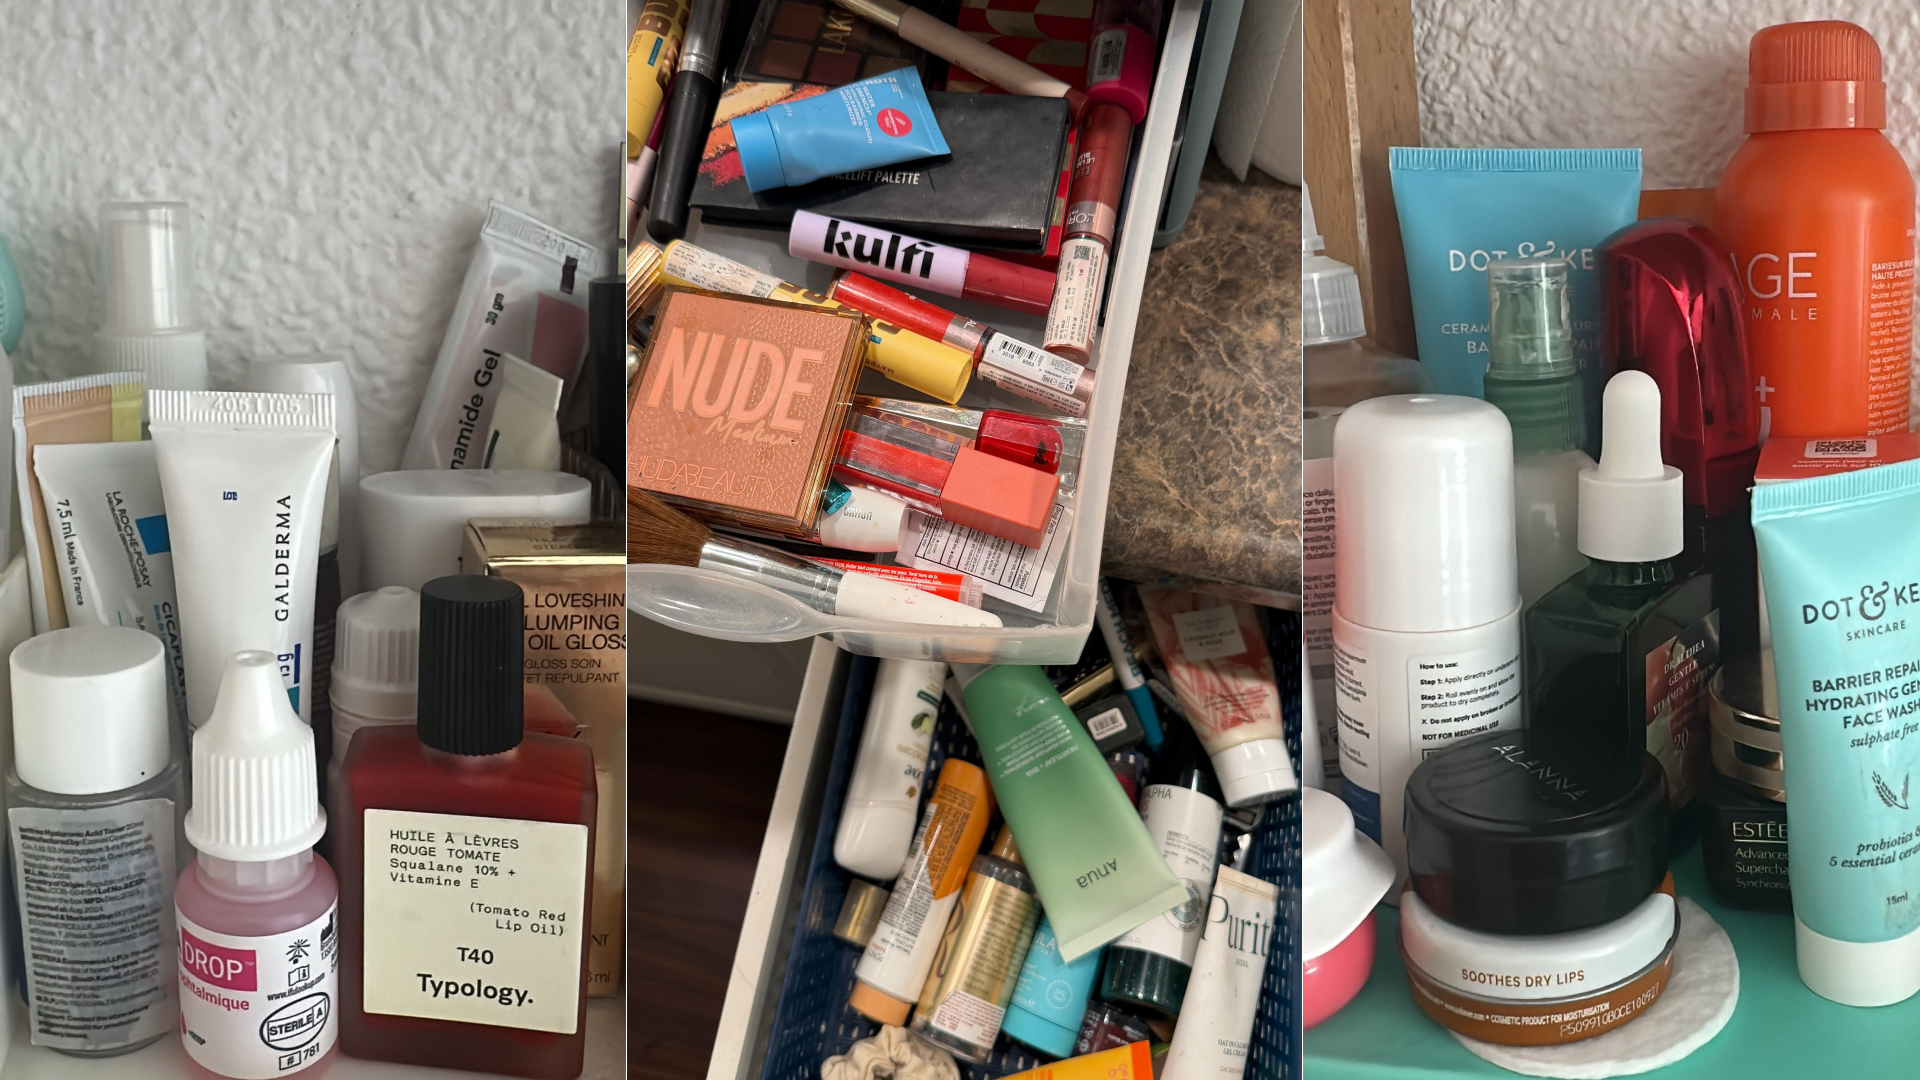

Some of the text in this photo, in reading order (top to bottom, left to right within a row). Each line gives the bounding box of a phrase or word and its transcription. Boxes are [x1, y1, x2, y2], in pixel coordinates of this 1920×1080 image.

[874, 171, 921, 185] PALETTE
[823, 219, 937, 281] kulfi
[485, 311, 498, 325] 30
[474, 349, 501, 388] Gel
[646, 327, 826, 432] NUDE
[704, 416, 800, 447] Medium
[112, 491, 152, 588] LA ROCHE-POSAY
[56, 499, 84, 605] 7,5 ml Made in France
[275, 495, 291, 622] GALDERMA
[1802, 581, 1920, 625] DOT & KE
[1846, 619, 1907, 642] SKINCARE
[528, 633, 560, 651] OIL
[571, 658, 602, 669] SOIN
[1669, 659, 1698, 686] GENTLE
[545, 672, 620, 684] REPULPANT
[1444, 676, 1462, 684] Apply
[1463, 670, 1486, 681] directly
[1812, 670, 1881, 693] BARRIER
[1421, 700, 1448, 709] product
[1458, 697, 1468, 706] dry
[1459, 688, 1478, 697] evenly
[1806, 687, 1899, 711] HYDRATING
[1843, 709, 1883, 729] FACE
[1454, 725, 1488, 737] MEDICINAL
[1675, 727, 1689, 756] 20
[1850, 722, 1919, 748] sulphate free
[390, 830, 519, 849] HUILE À LÈVRES
[1856, 833, 1913, 856] probiotics
[390, 844, 501, 862] ROUGE TOMATE
[1829, 850, 1896, 869] 5 essential
[390, 859, 516, 877] Squalane 10% +
[1076, 858, 1118, 888] Anua
[390, 873, 479, 889] Vitamine E
[1886, 892, 1908, 906] 15ml
[470, 901, 566, 923] (Tomato Red
[495, 919, 564, 937] Lip Oil)
[184, 940, 243, 981] DROP
[456, 946, 494, 965] T40
[1461, 968, 1585, 989] SOOTHES DRY LIPS
[416, 972, 534, 1007] Typology.
[269, 1007, 323, 1036] STERILE A
[1490, 1014, 1521, 1026] COSMETIC
[1521, 1015, 1551, 1026] PRODUCT
[1551, 1013, 1563, 1024] FOR
[303, 1042, 320, 1060] 781
